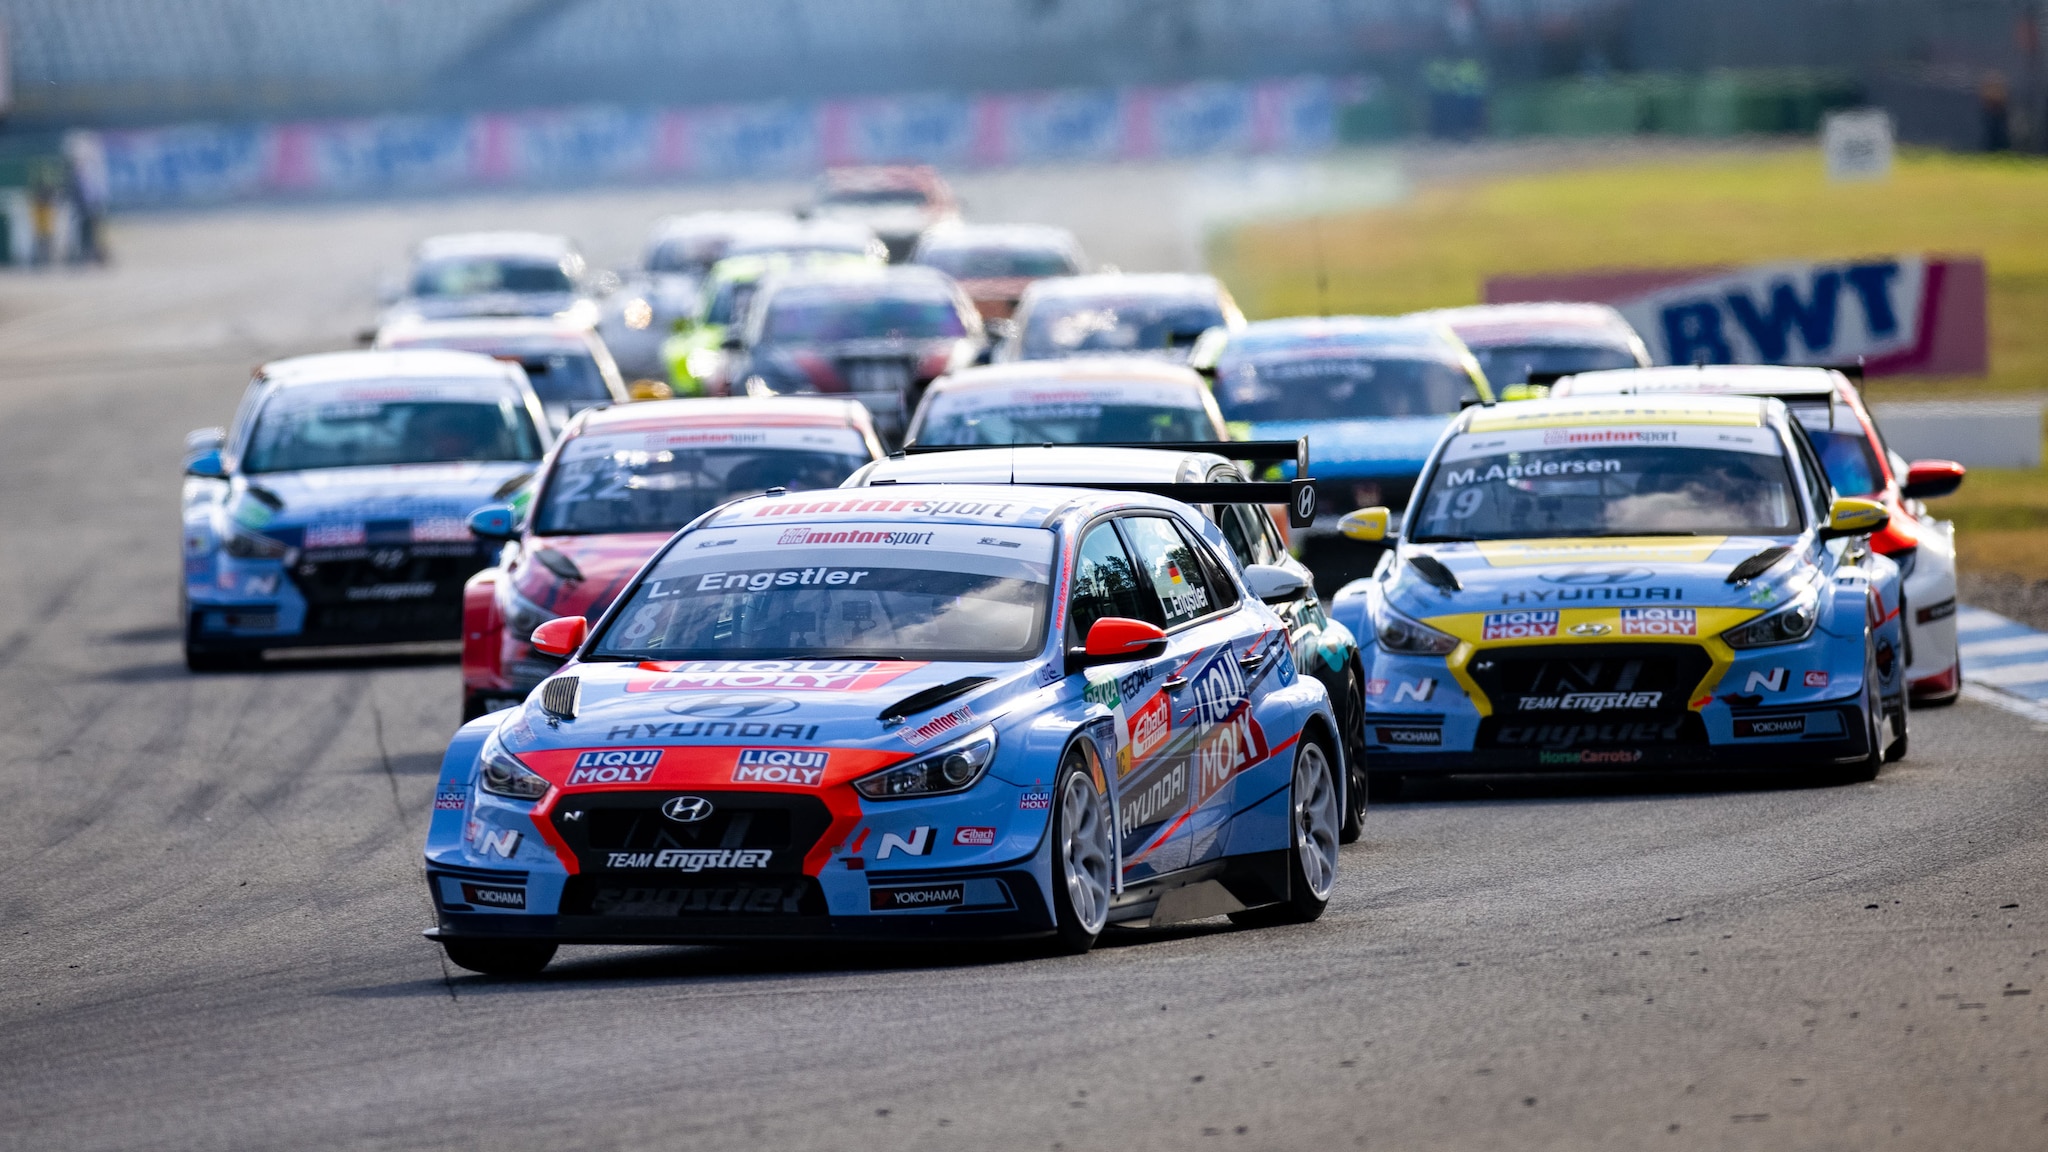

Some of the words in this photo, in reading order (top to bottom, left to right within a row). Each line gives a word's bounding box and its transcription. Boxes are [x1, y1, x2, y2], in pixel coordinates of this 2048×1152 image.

[1661, 260, 1899, 364] BWT
[1447, 458, 1622, 487] M.Andersen
[1427, 487, 1483, 522] 19
[806, 530, 935, 546] motorsport
[647, 581, 681, 599] L.
[696, 567, 869, 591] Engstler
[1168, 583, 1209, 619] Engstler
[1502, 588, 1683, 605] HYUNDAI
[624, 602, 663, 640] 8
[1486, 611, 1558, 625] LIQUI
[1622, 608, 1694, 622] LIQUI
[1485, 624, 1558, 639] MOLY
[1624, 621, 1697, 635] MOLY
[664, 674, 855, 688] MOLY
[1195, 648, 1246, 736] LIQUI
[1517, 697, 1560, 711] TEAM
[1560, 691, 1663, 712] Engstler
[606, 722, 820, 741] HYUNDAI
[1132, 698, 1168, 758] Eibach
[1752, 721, 1803, 733] YOKOHAMA
[1390, 732, 1440, 742] YOKOHAMA
[579, 751, 658, 767] LIQUI
[742, 751, 828, 768] LIQUI
[1202, 707, 1258, 797] MOLY
[571, 766, 652, 784] MOLY
[737, 766, 822, 784] MOLY
[438, 792, 466, 801] LIQUI
[1020, 800, 1049, 809] MOLY
[1022, 793, 1049, 801] LIQUI
[1122, 761, 1185, 839] HYUNDAI
[436, 801, 464, 810] MOLY
[957, 828, 994, 844] Eibach
[605, 853, 653, 868] TEAM
[654, 849, 773, 872] Engstler
[475, 889, 524, 904] YOKOHAMA
[894, 889, 960, 904] YOKOHAMA
